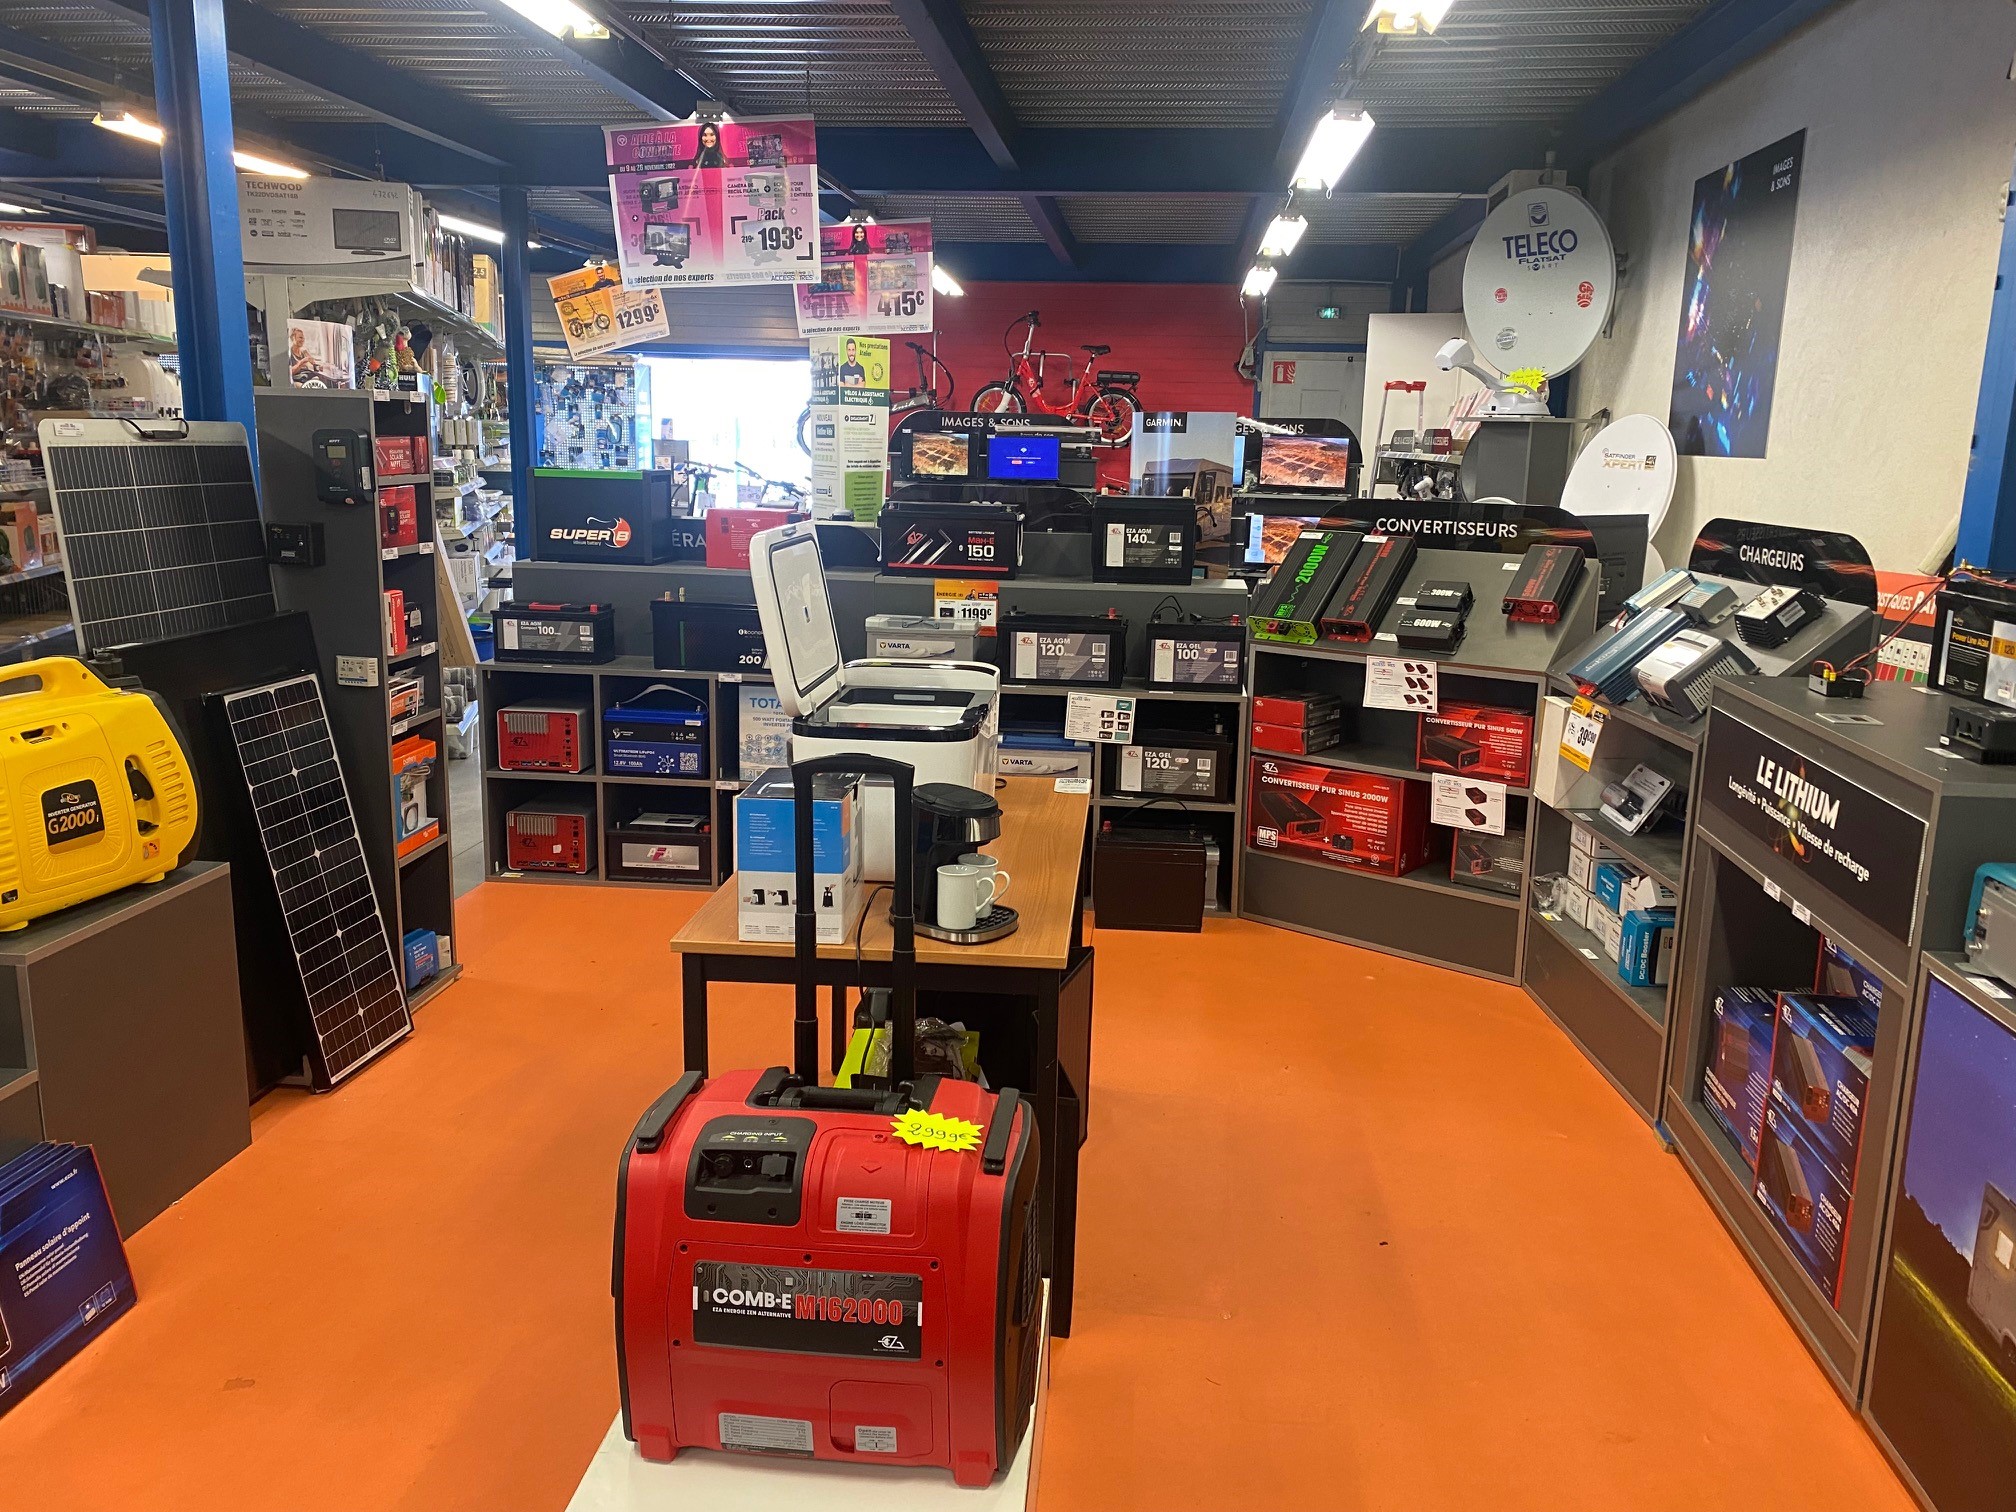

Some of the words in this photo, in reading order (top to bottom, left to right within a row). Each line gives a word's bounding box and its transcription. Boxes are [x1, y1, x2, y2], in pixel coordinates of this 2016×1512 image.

[245, 180, 303, 191] TECHWOOD
[757, 207, 786, 221] Pack
[757, 226, 803, 251] 193€
[1502, 228, 1578, 260] TELECO
[1518, 253, 1567, 265] FLATSAT
[663, 274, 673, 282] de
[673, 274, 687, 282] nos
[687, 274, 714, 283] experts
[878, 290, 925, 317] 415€
[616, 303, 660, 330] 1299€
[941, 416, 985, 427] IMAGES
[988, 417, 996, 427] &
[1602, 459, 1645, 470] XPERT
[549, 528, 611, 541] SUPER
[615, 530, 630, 541] B
[1375, 517, 1519, 538] CONVERTISSEURS
[1126, 533, 1148, 544] 140
[967, 544, 995, 558] 150
[1739, 544, 1805, 572] CHARGEURS
[1294, 544, 1330, 584] 2000W
[1430, 588, 1454, 597] 300W
[960, 607, 992, 621] 1199€
[1413, 618, 1442, 628] 600W
[538, 626, 555, 636] 100
[887, 642, 911, 650] VARTA
[1040, 643, 1065, 656] 120
[738, 655, 762, 665] 200
[1176, 648, 1199, 660] 100
[1425, 716, 1473, 729] CONVERTISSEUR
[1473, 722, 1486, 730] PUR
[1487, 724, 1505, 733] SINUS
[1144, 750, 1157, 758] EZA
[1145, 757, 1169, 770] 120
[1261, 775, 1320, 792] CONVERTISSEUR
[1321, 786, 1336, 795] PUR
[1337, 788, 1361, 799] SINUS
[1361, 792, 1389, 804] 2000W
[1756, 755, 1776, 790] LE
[1773, 766, 1841, 830] LITHIUM
[47, 806, 70, 818] INVERTER
[70, 800, 97, 812] GENERATOR
[1259, 828, 1277, 841] MPS
[1728, 775, 1757, 805] Longévité
[1760, 797, 1792, 829] Puissance
[1797, 820, 1823, 851] Vitesse
[1823, 839, 1834, 856] de
[1834, 848, 1870, 883] recharge
[1640, 931, 1650, 958] Booster
[1638, 958, 1647, 980] DC/DC
[907, 1122, 971, 1143] 2999€
[14, 1247, 42, 1272] Panneau
[41, 1232, 62, 1253] solaire
[61, 1211, 91, 1238] d'appoint
[712, 1287, 792, 1310] COMB-E
[795, 1293, 903, 1326] M162000
[723, 1307, 746, 1315] ENERGIE
[746, 1308, 757, 1316] ZEN
[757, 1309, 792, 1319] ALTERNATIVE
